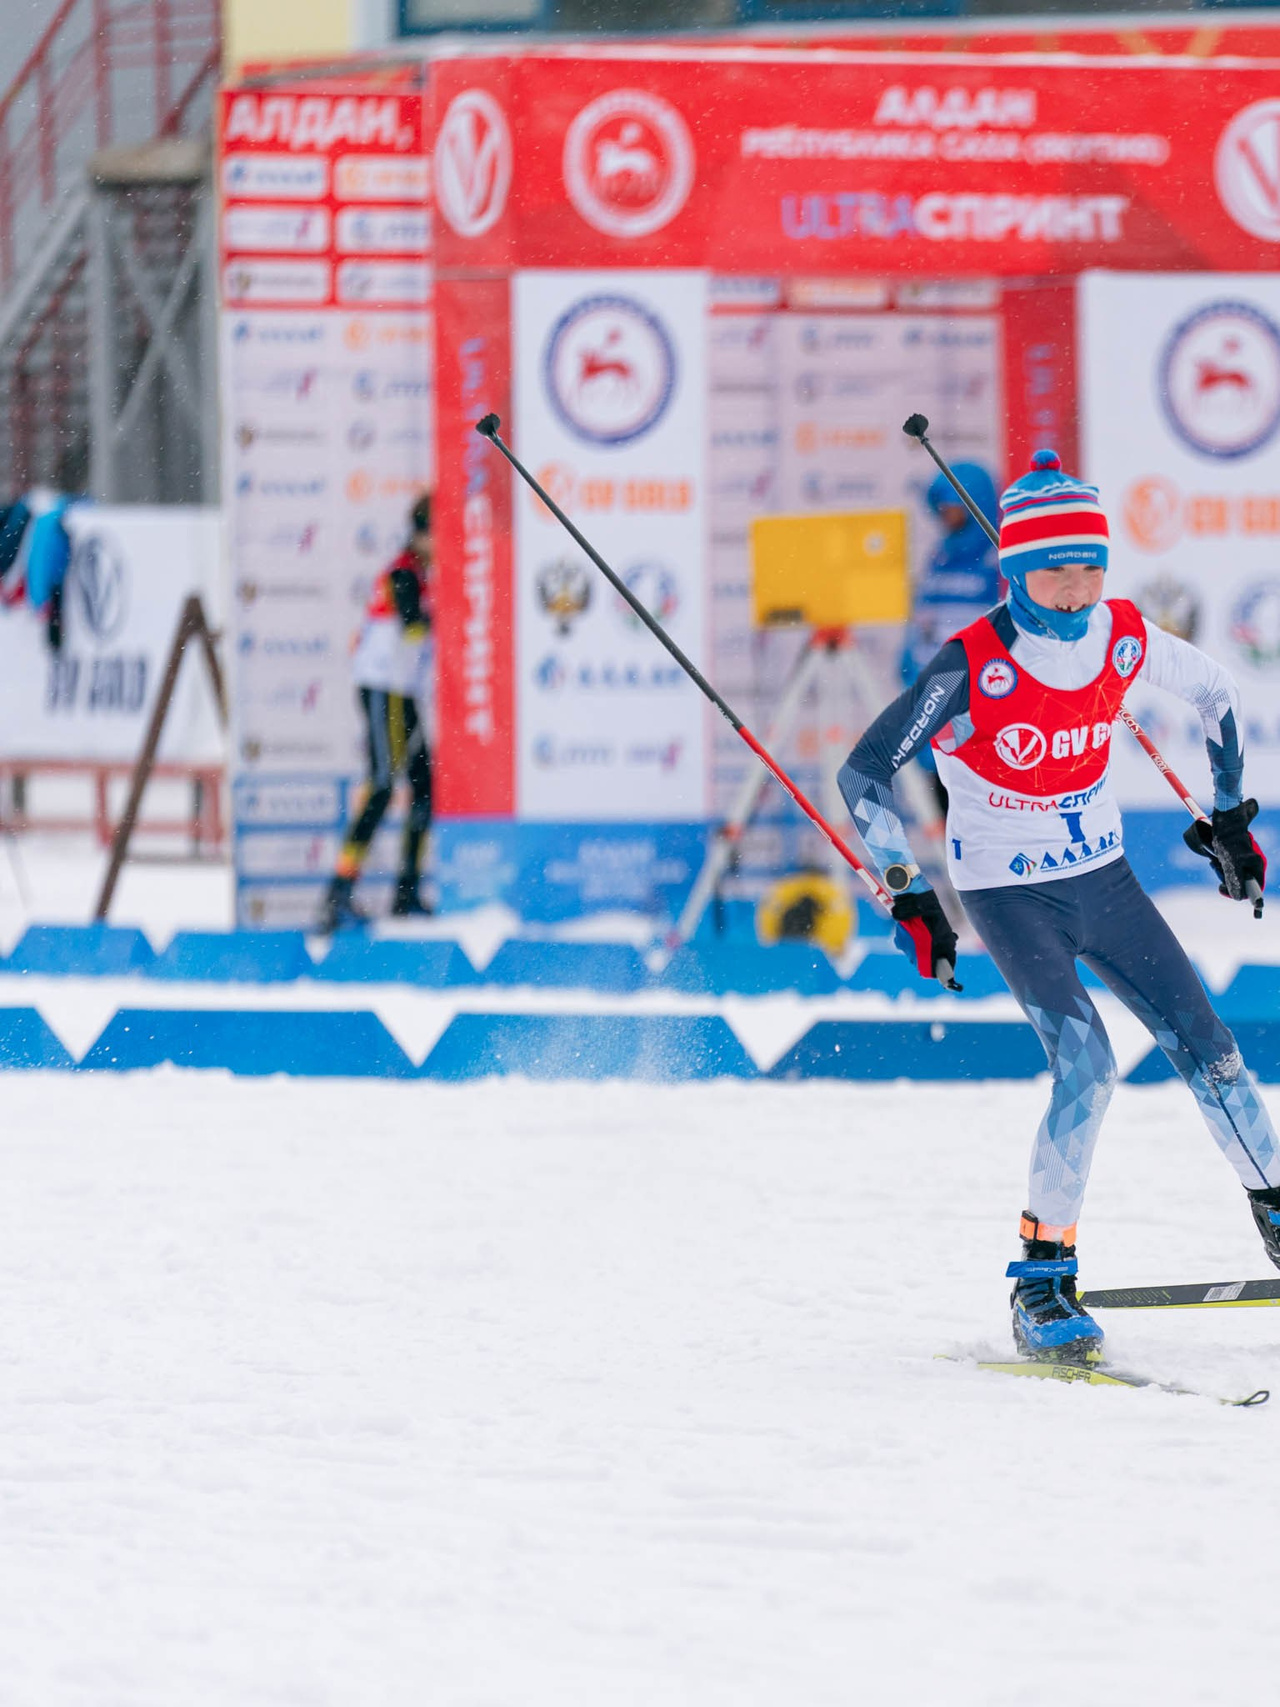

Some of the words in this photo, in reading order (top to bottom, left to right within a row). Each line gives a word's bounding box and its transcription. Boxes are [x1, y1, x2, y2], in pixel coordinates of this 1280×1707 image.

[227, 95, 414, 150] АЛДАН,
[891, 685, 946, 769] NORDSKI
[1052, 726, 1088, 760] GV
[1052, 1366, 1092, 1384] FISCHER
